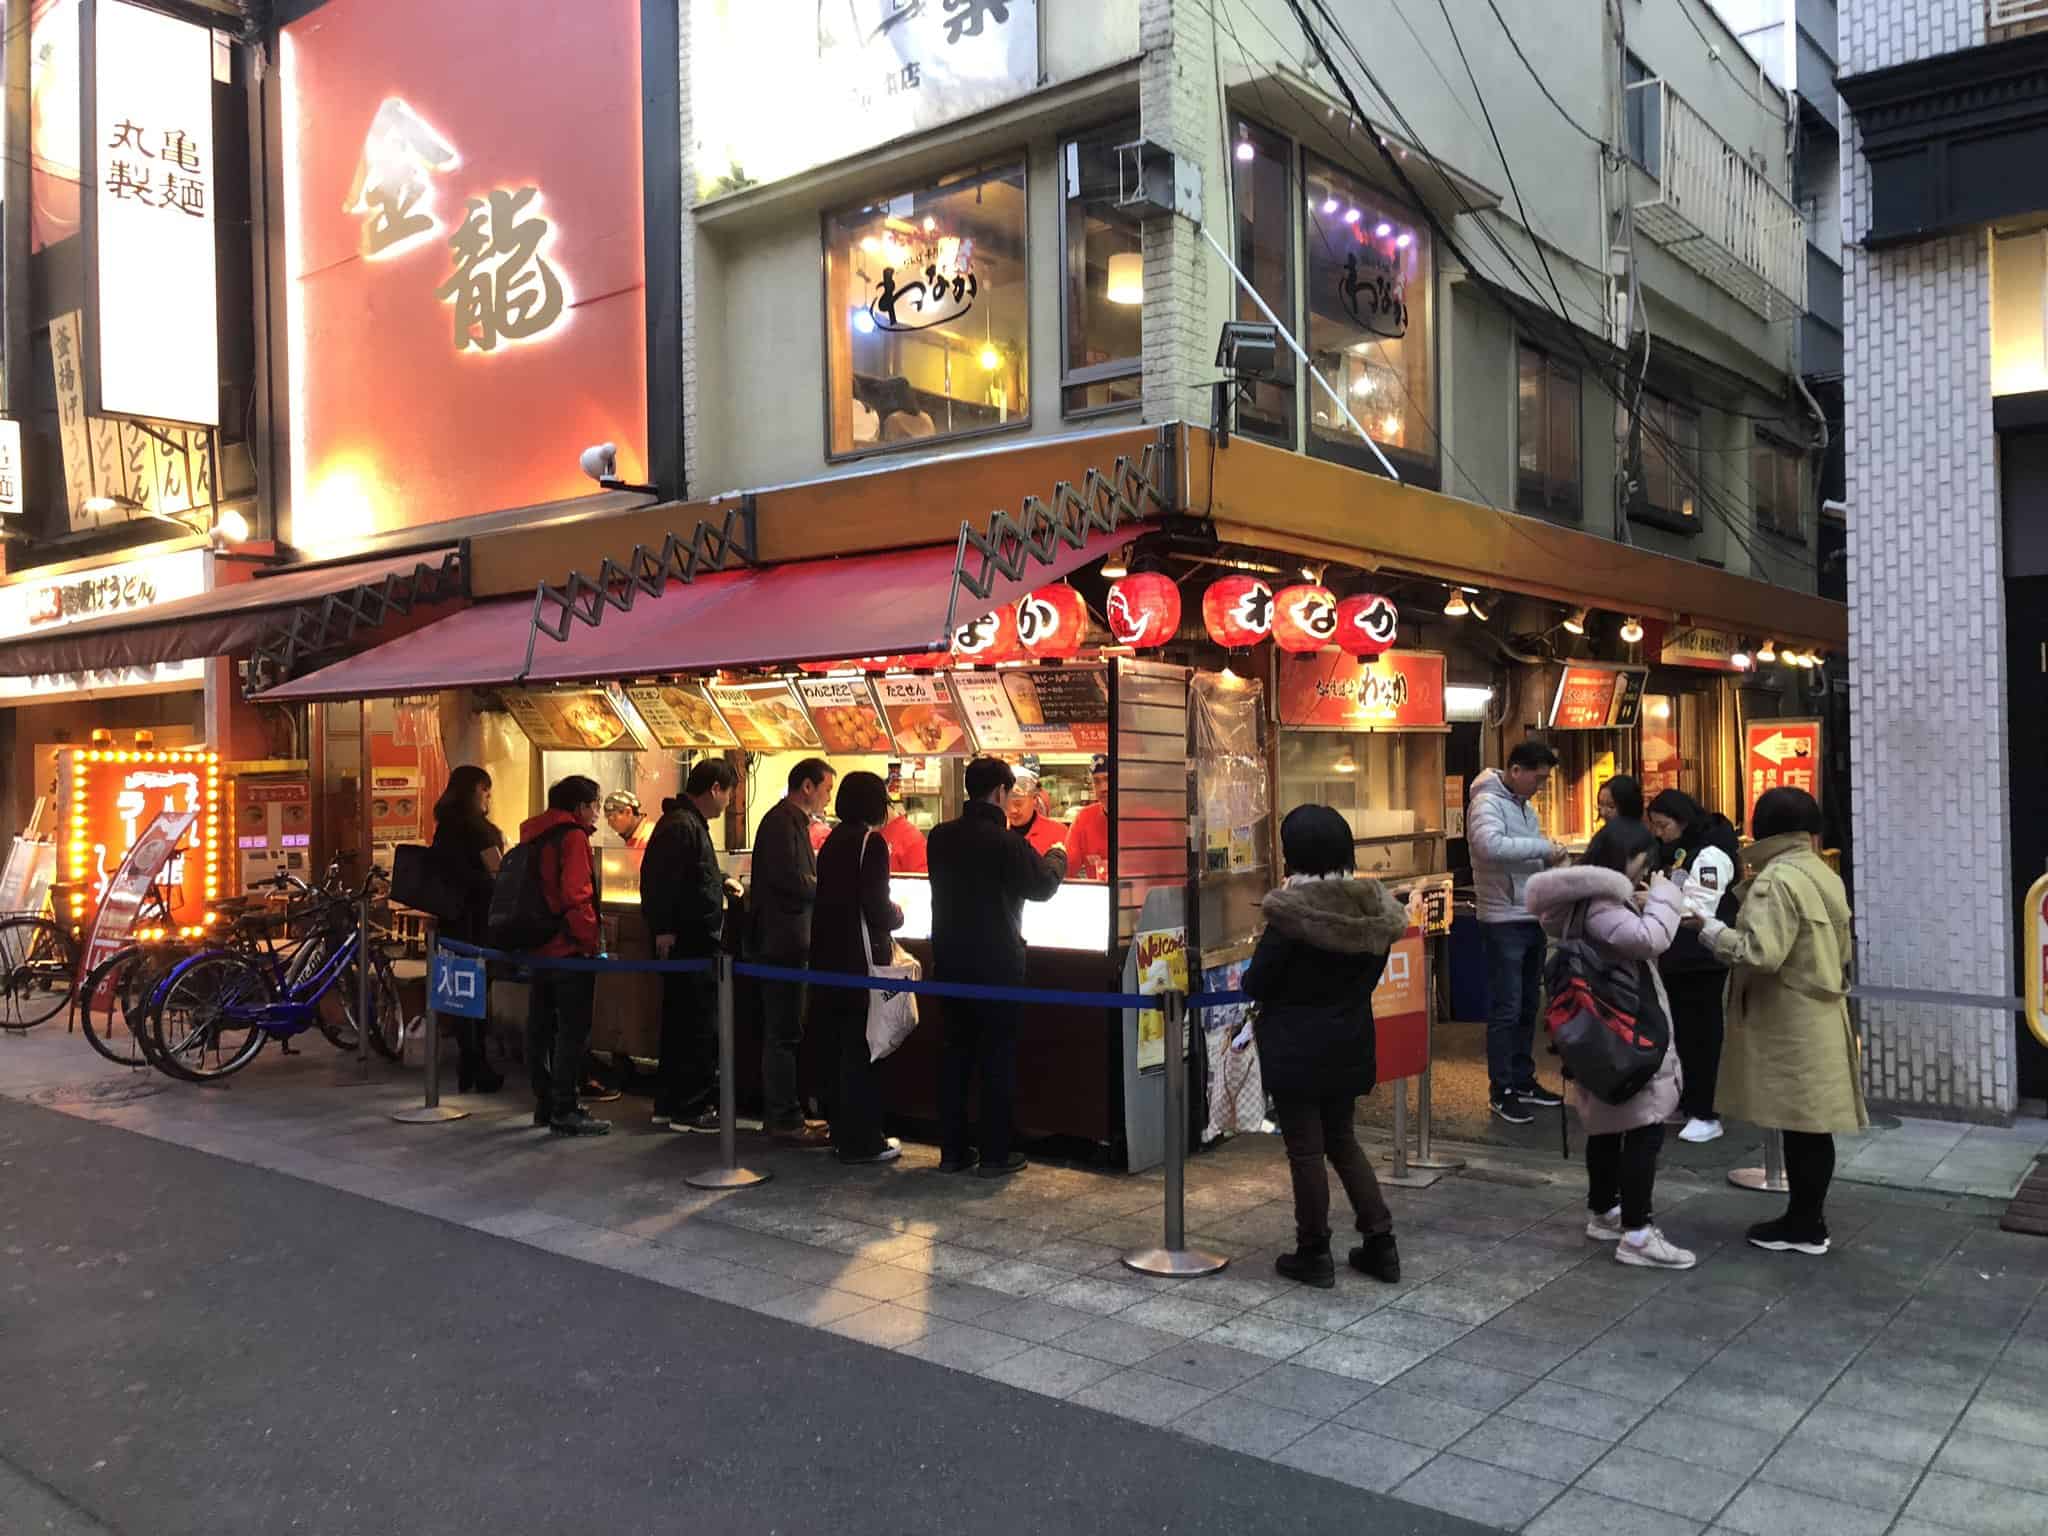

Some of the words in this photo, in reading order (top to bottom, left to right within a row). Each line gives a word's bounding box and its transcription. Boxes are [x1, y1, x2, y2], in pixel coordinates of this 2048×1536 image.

[108, 118, 201, 174] 丸亀
[105, 159, 205, 218] 製麺
[342, 96, 569, 352] 金龍
[876, 264, 978, 327] わなか
[887, 684, 926, 698] たこせん
[1358, 664, 1407, 707] わなか
[437, 965, 476, 999] 入口
